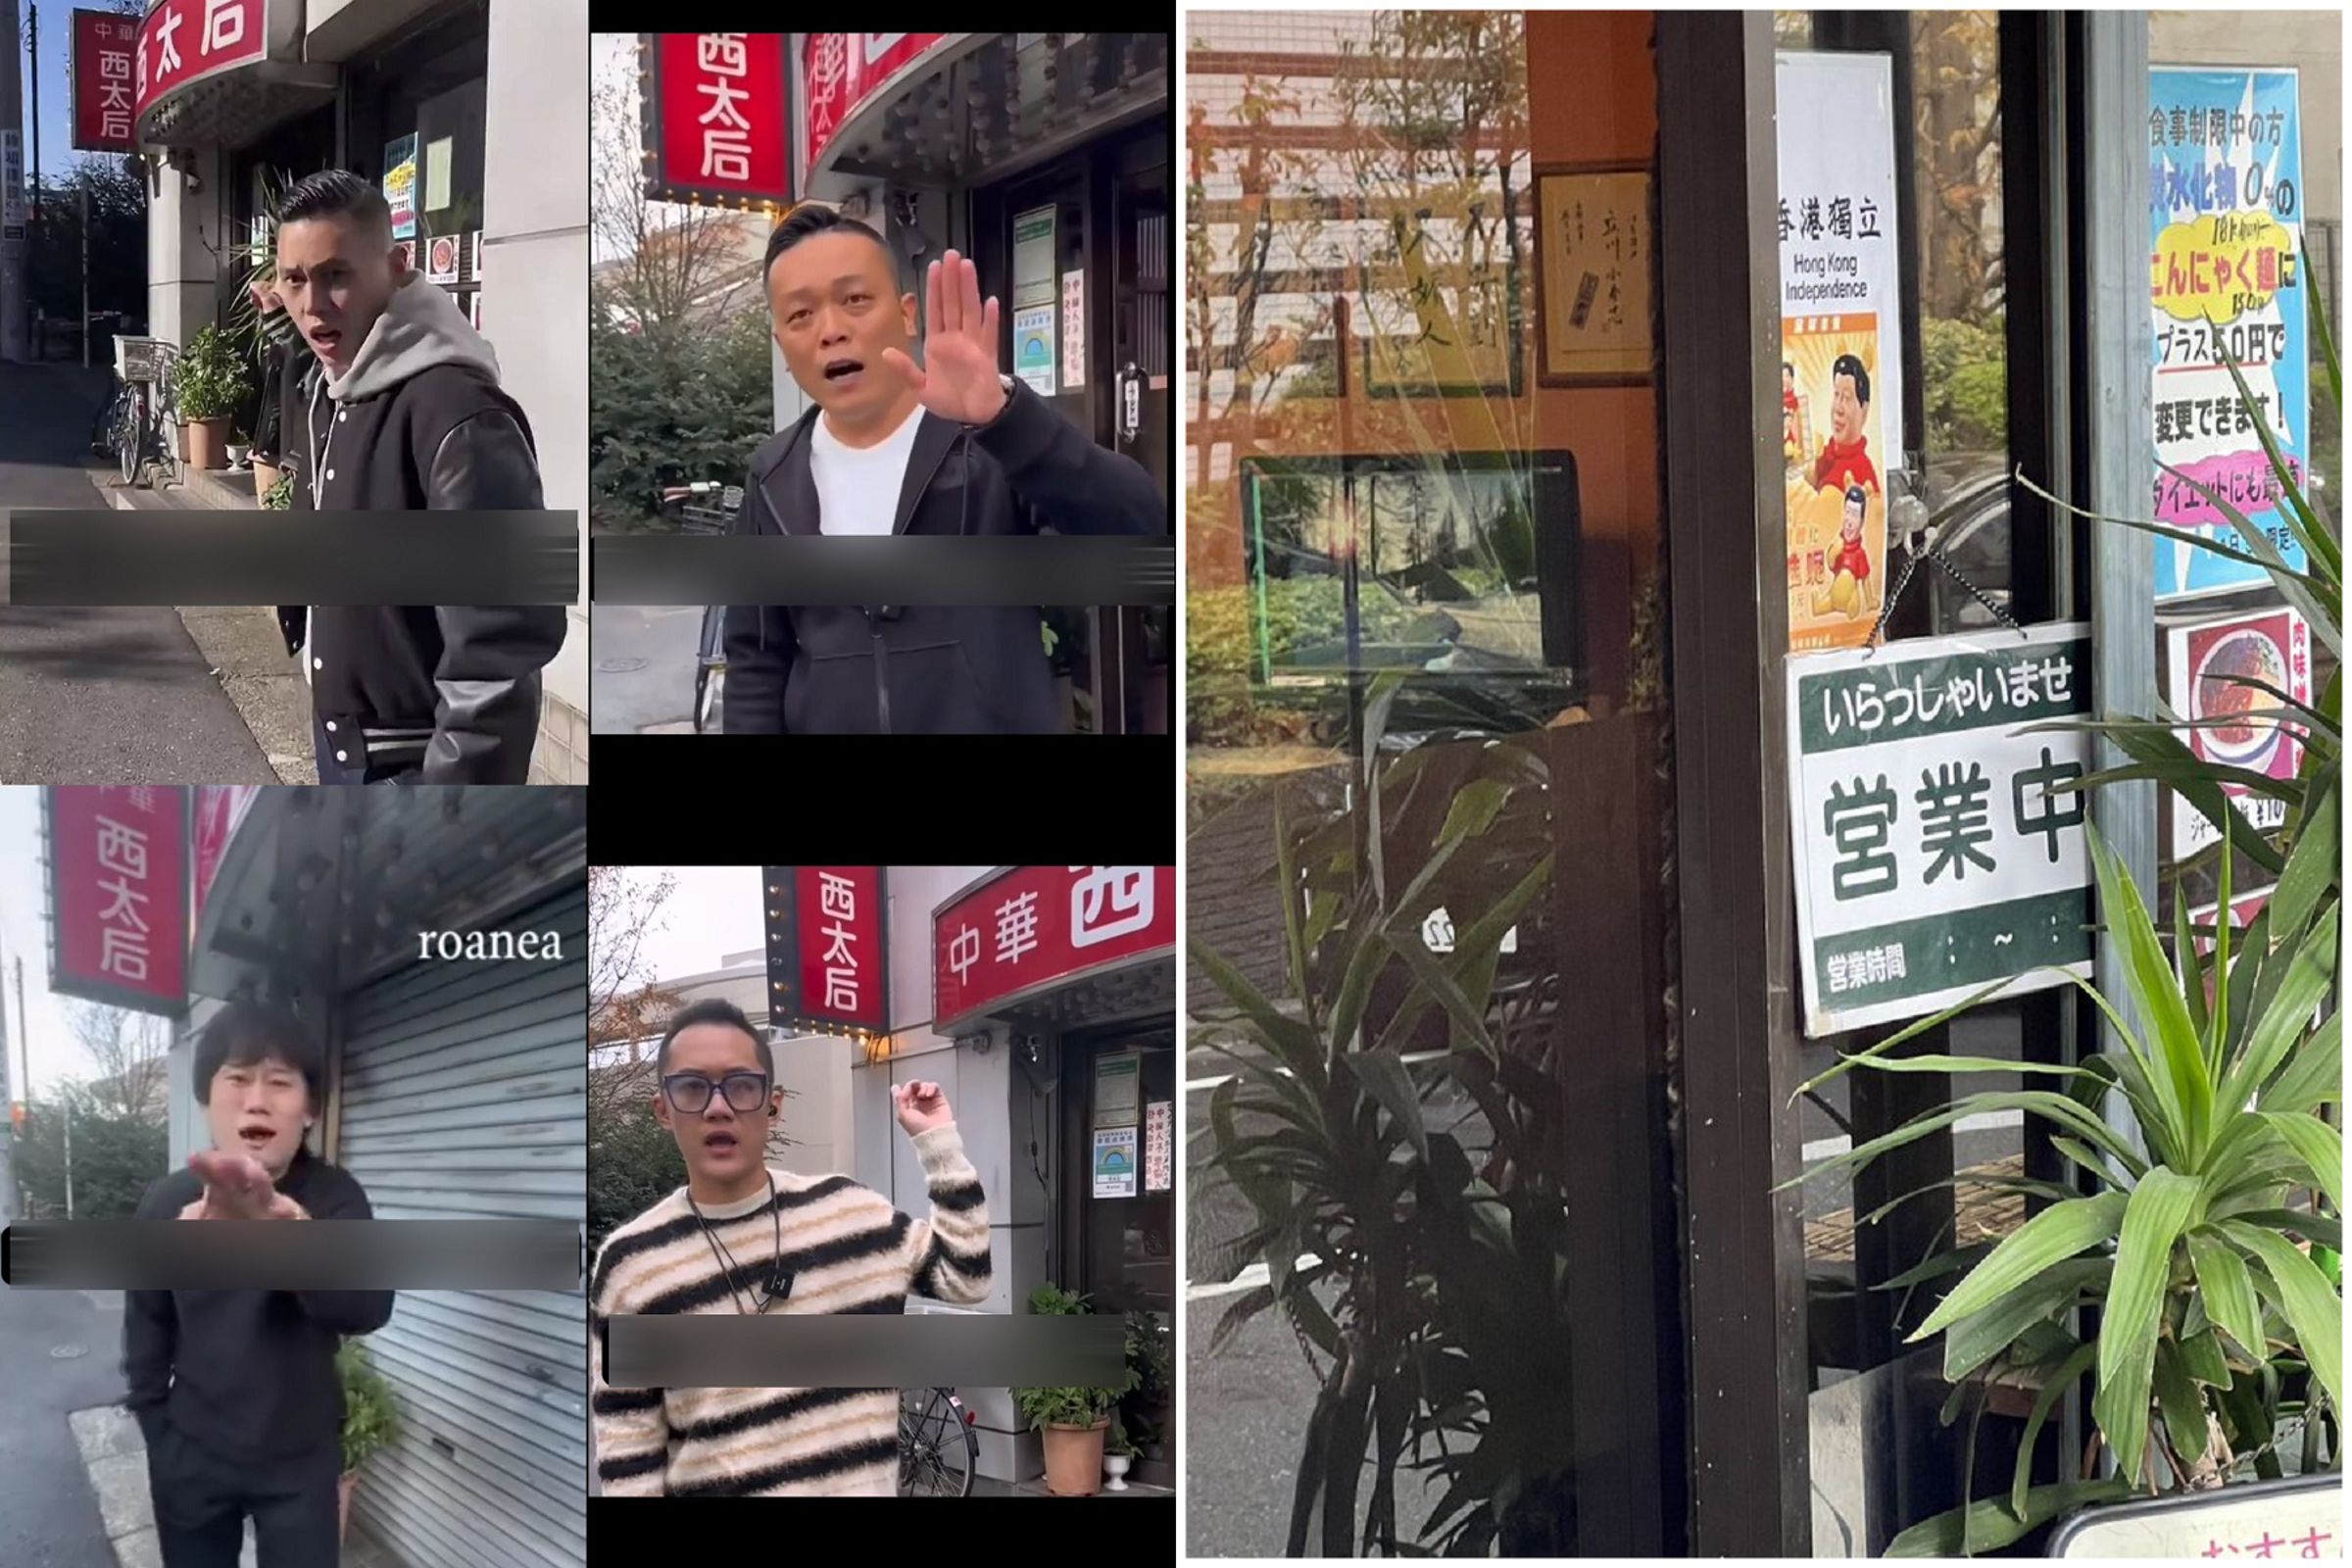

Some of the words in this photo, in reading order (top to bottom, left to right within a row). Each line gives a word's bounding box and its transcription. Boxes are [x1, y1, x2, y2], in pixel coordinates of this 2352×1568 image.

[99, 50, 131, 139] 西太后
[697, 33, 752, 180] 西太后
[2149, 106, 2284, 147] 食事制限中の方
[1786, 277, 1867, 306] Independence
[1793, 253, 1825, 278] Hong
[1828, 251, 1858, 277] Kong
[1824, 656, 2073, 736] いらっしゃいませ
[1824, 747, 2085, 902] 営業中
[97, 813, 149, 980] 西太后
[819, 871, 858, 1011] 西太后
[951, 892, 1038, 986] 中華
[1828, 942, 1906, 994] 営業時間
